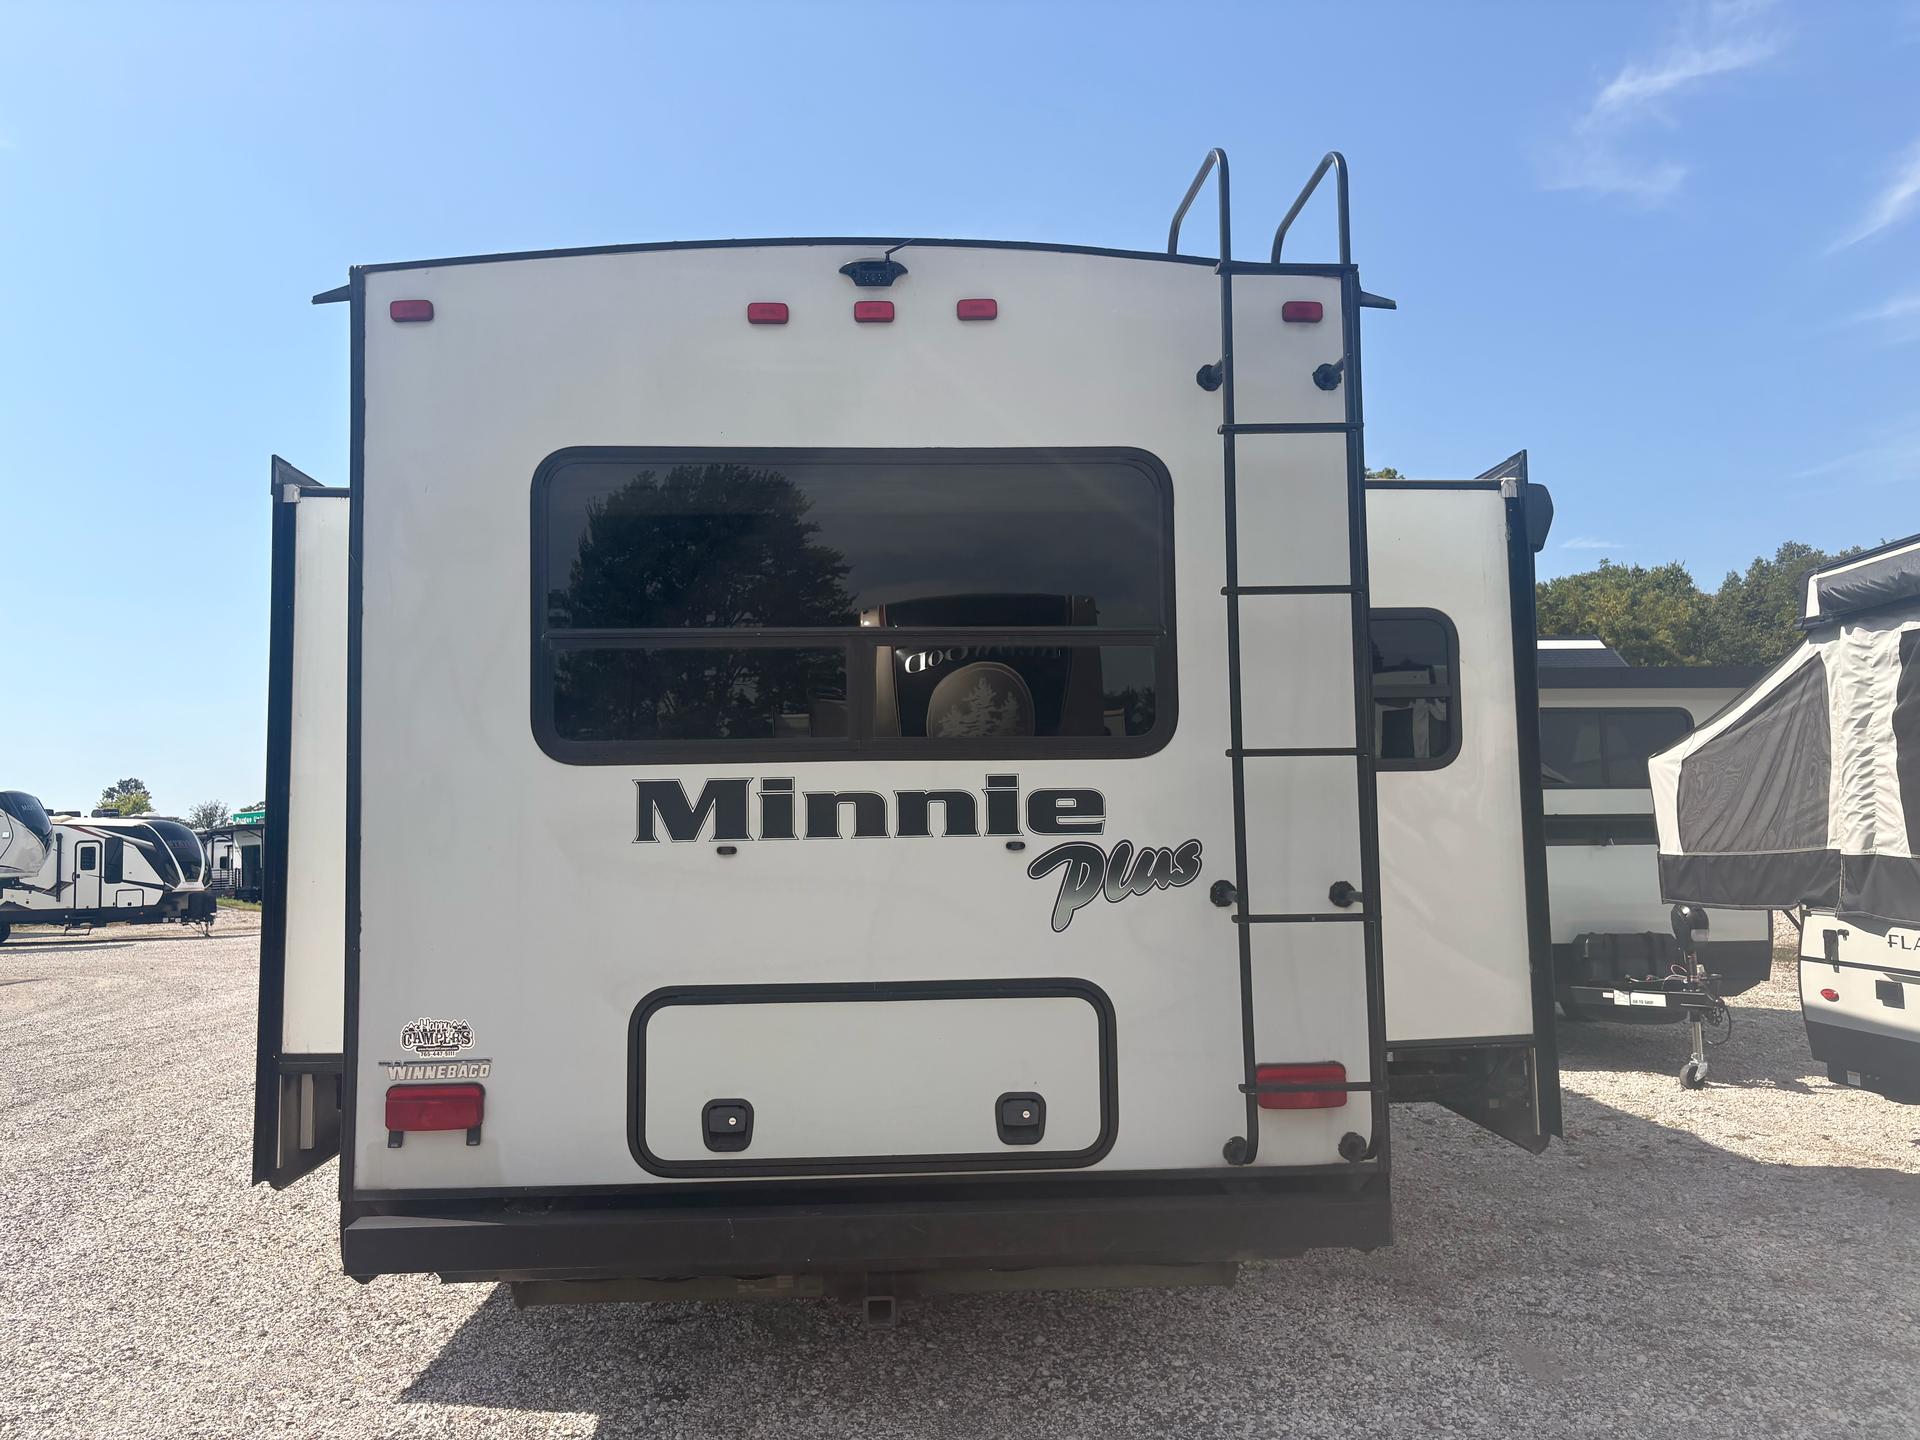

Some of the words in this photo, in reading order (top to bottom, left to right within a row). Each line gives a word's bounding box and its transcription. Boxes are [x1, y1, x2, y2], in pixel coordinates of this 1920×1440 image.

[631, 773, 1106, 844] Minnie
[1028, 838, 1203, 933] Plus
[416, 1018, 454, 1031] Happy
[403, 1030, 471, 1047] CAMPERS
[386, 1063, 492, 1081] WINNEBAGO
